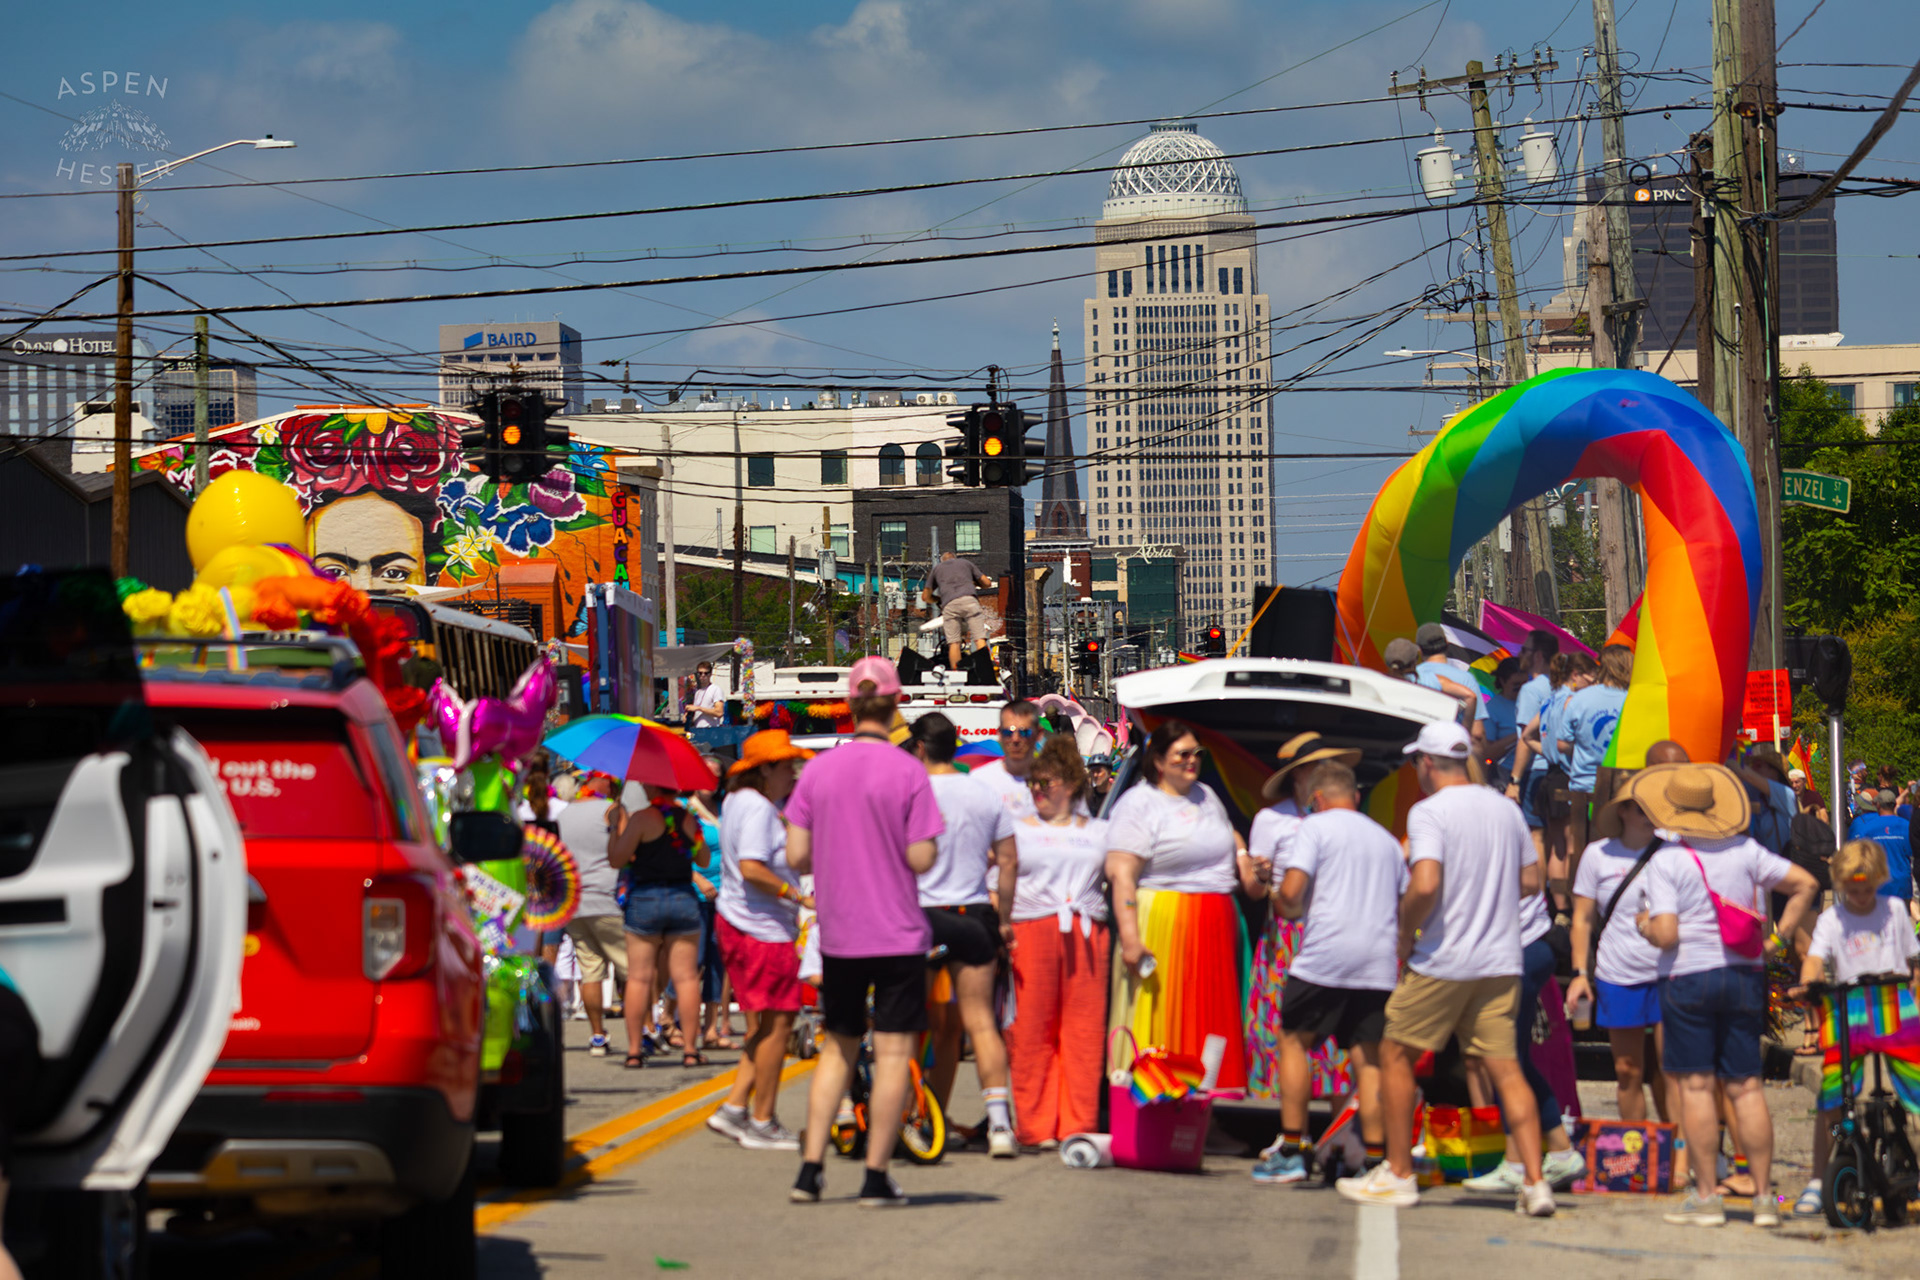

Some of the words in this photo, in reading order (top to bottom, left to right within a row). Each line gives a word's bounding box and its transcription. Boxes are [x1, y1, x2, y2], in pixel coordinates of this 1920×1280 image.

[1653, 188, 1687, 201] PNC
[487, 332, 537, 347] BAIRD
[1784, 476, 1826, 501] ENZEL
[1114, 534, 1175, 565] Atria
[221, 760, 268, 778] out
